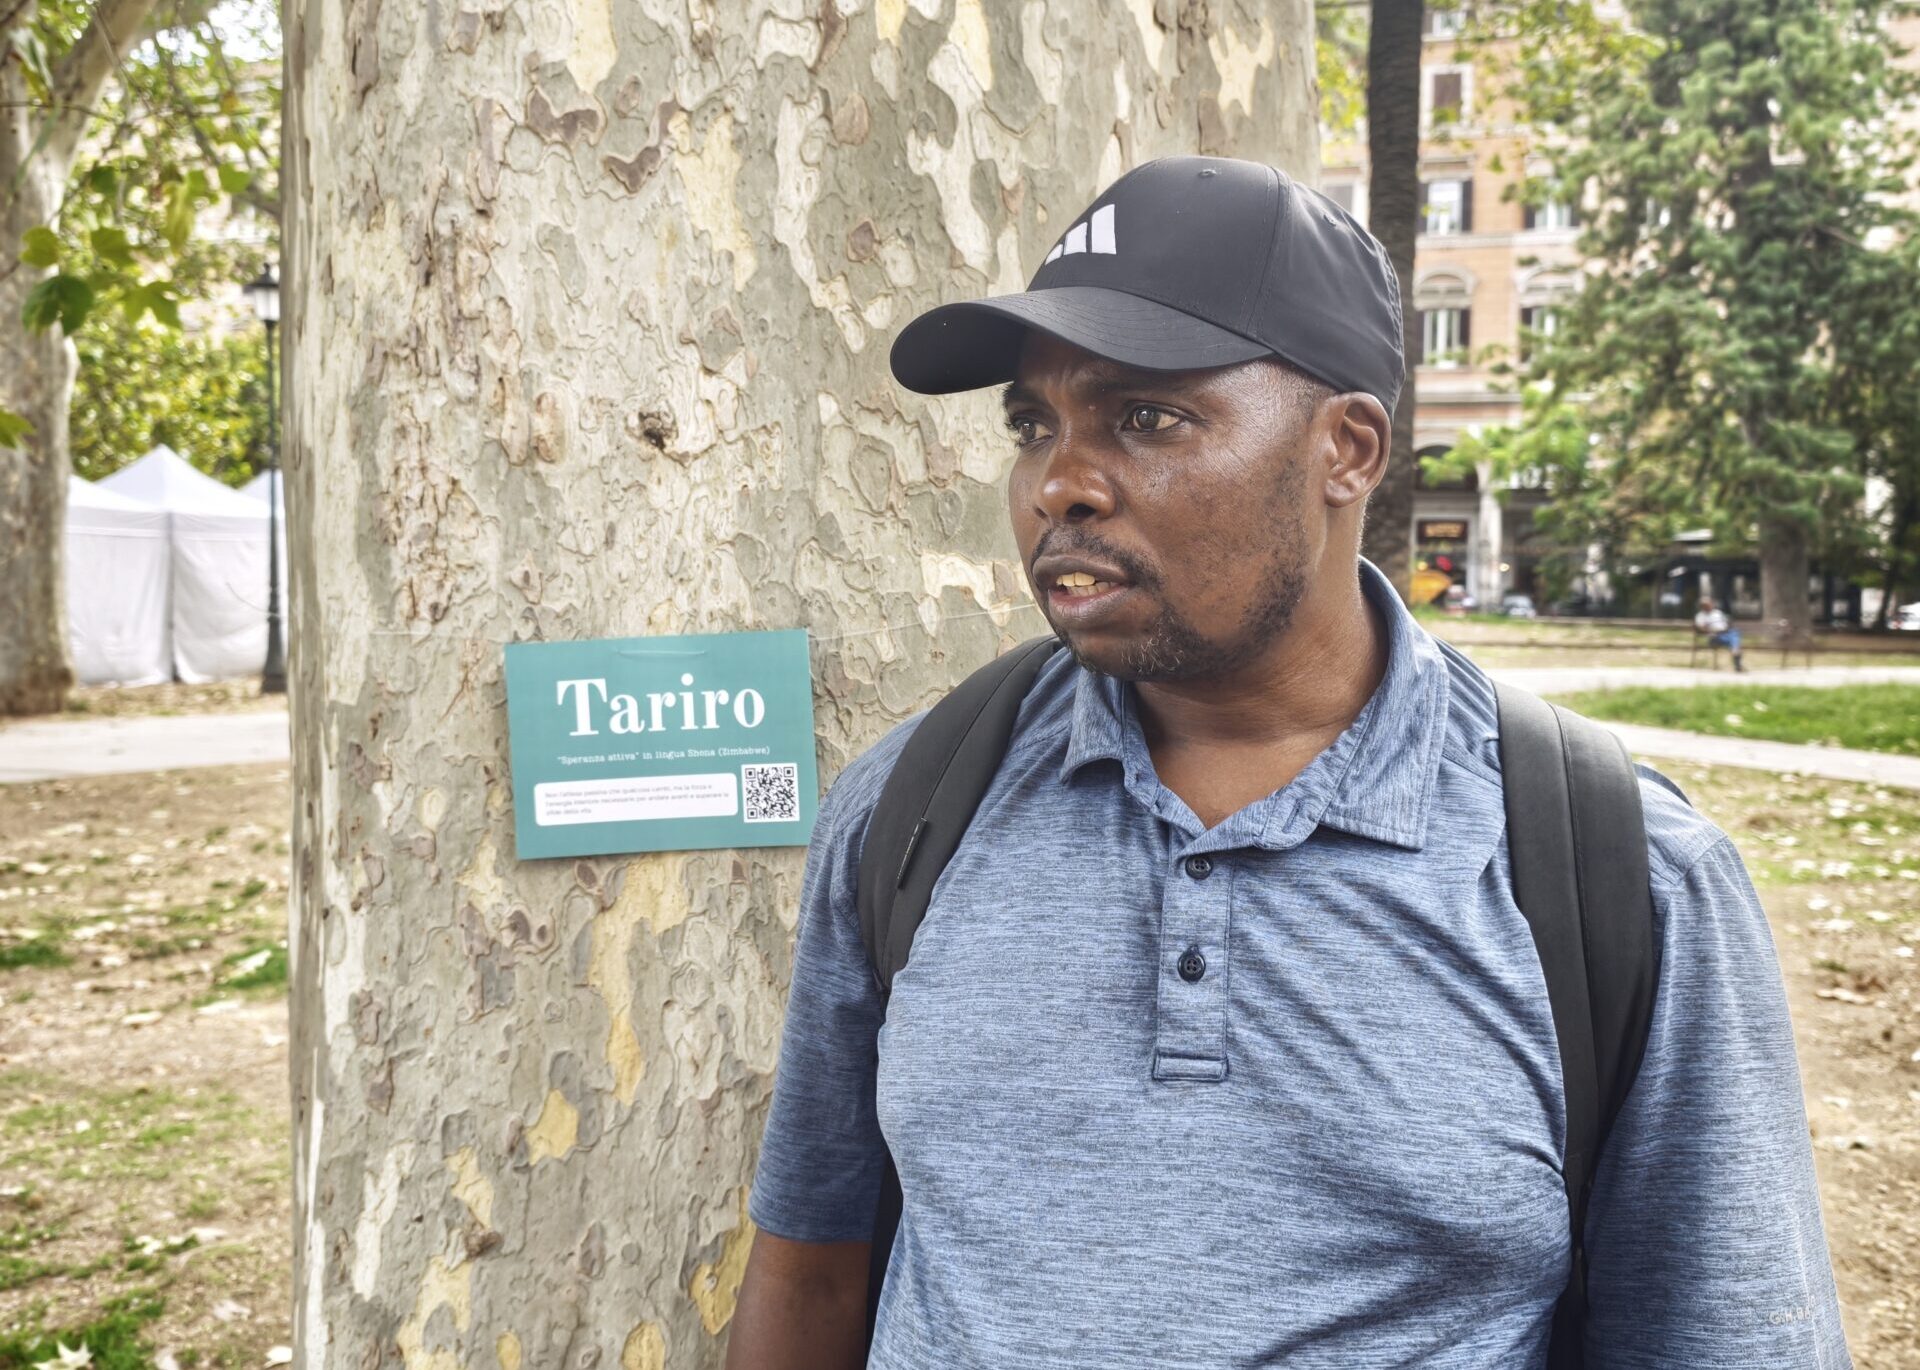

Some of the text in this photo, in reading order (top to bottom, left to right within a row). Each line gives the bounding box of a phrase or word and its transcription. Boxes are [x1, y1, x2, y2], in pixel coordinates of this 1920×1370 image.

[557, 673, 765, 736] Tariro
[643, 752, 653, 760] in
[656, 750, 685, 760] lingua
[688, 749, 715, 758] Shona
[718, 746, 770, 757] (Zimbabwe)
